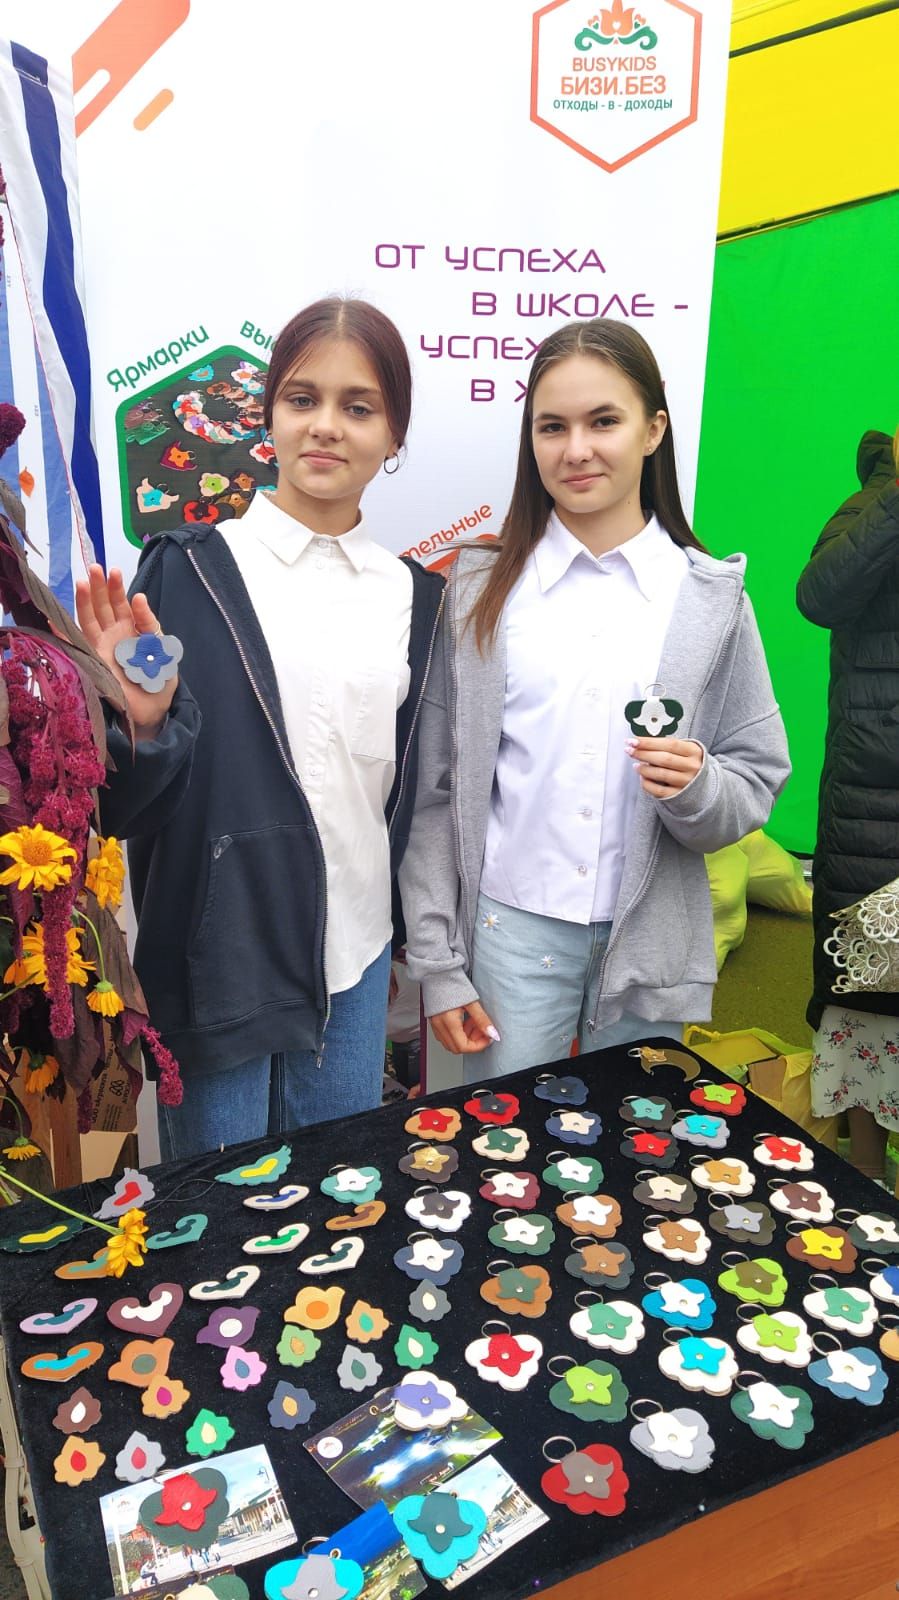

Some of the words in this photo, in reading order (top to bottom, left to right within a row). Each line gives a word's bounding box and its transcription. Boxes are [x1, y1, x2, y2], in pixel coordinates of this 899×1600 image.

[572, 56, 657, 72] BUSYKIDS
[560, 75, 667, 95] БИЗИ.БЕЗ
[553, 99, 599, 112] ОТХОДЫ
[608, 100, 615, 110] В
[624, 98, 673, 112] ДОХОДЫ
[375, 243, 425, 269] ОТ
[445, 245, 606, 274] УСПЕХА
[471, 291, 497, 316] В
[516, 293, 655, 317] ШКОЛЕ
[106, 325, 210, 393] Ярмарки
[471, 378, 495, 402] В
